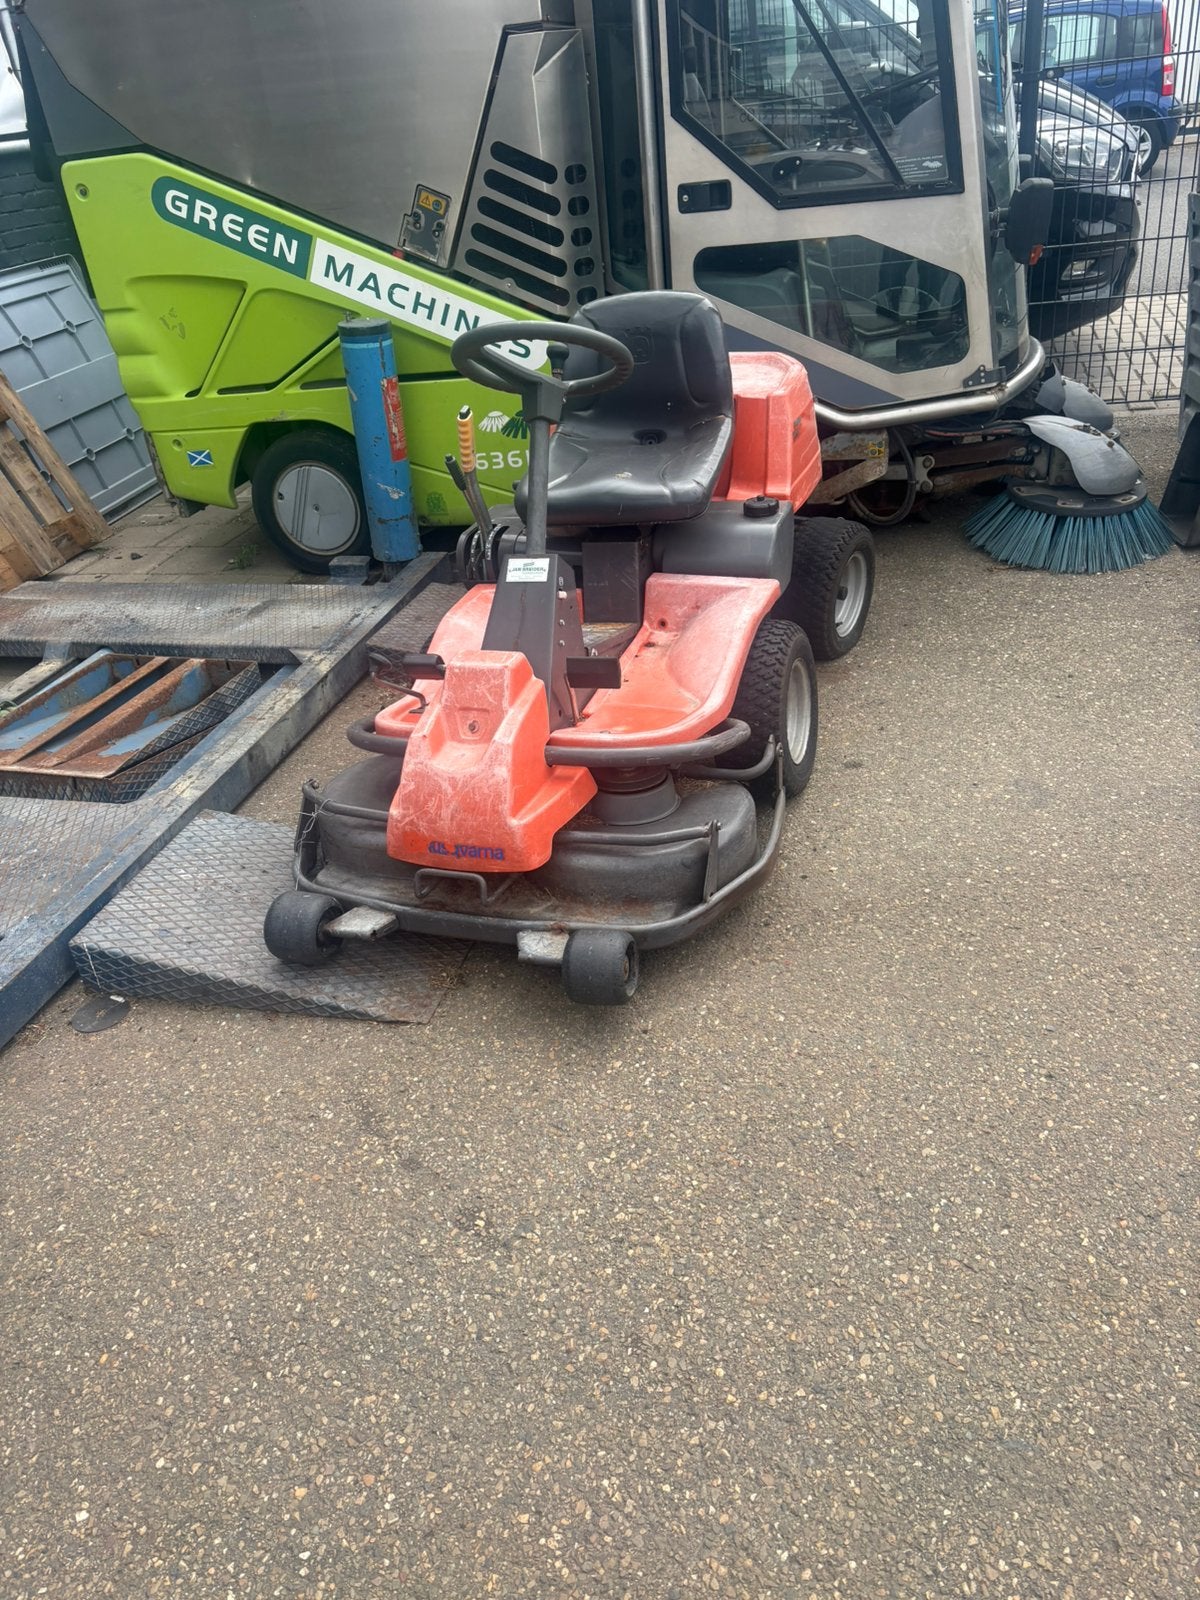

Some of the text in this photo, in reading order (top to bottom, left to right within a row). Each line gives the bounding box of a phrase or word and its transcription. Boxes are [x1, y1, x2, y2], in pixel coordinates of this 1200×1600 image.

[165, 189, 532, 359] GREEN MACHINS
[475, 449, 529, 470] 636
